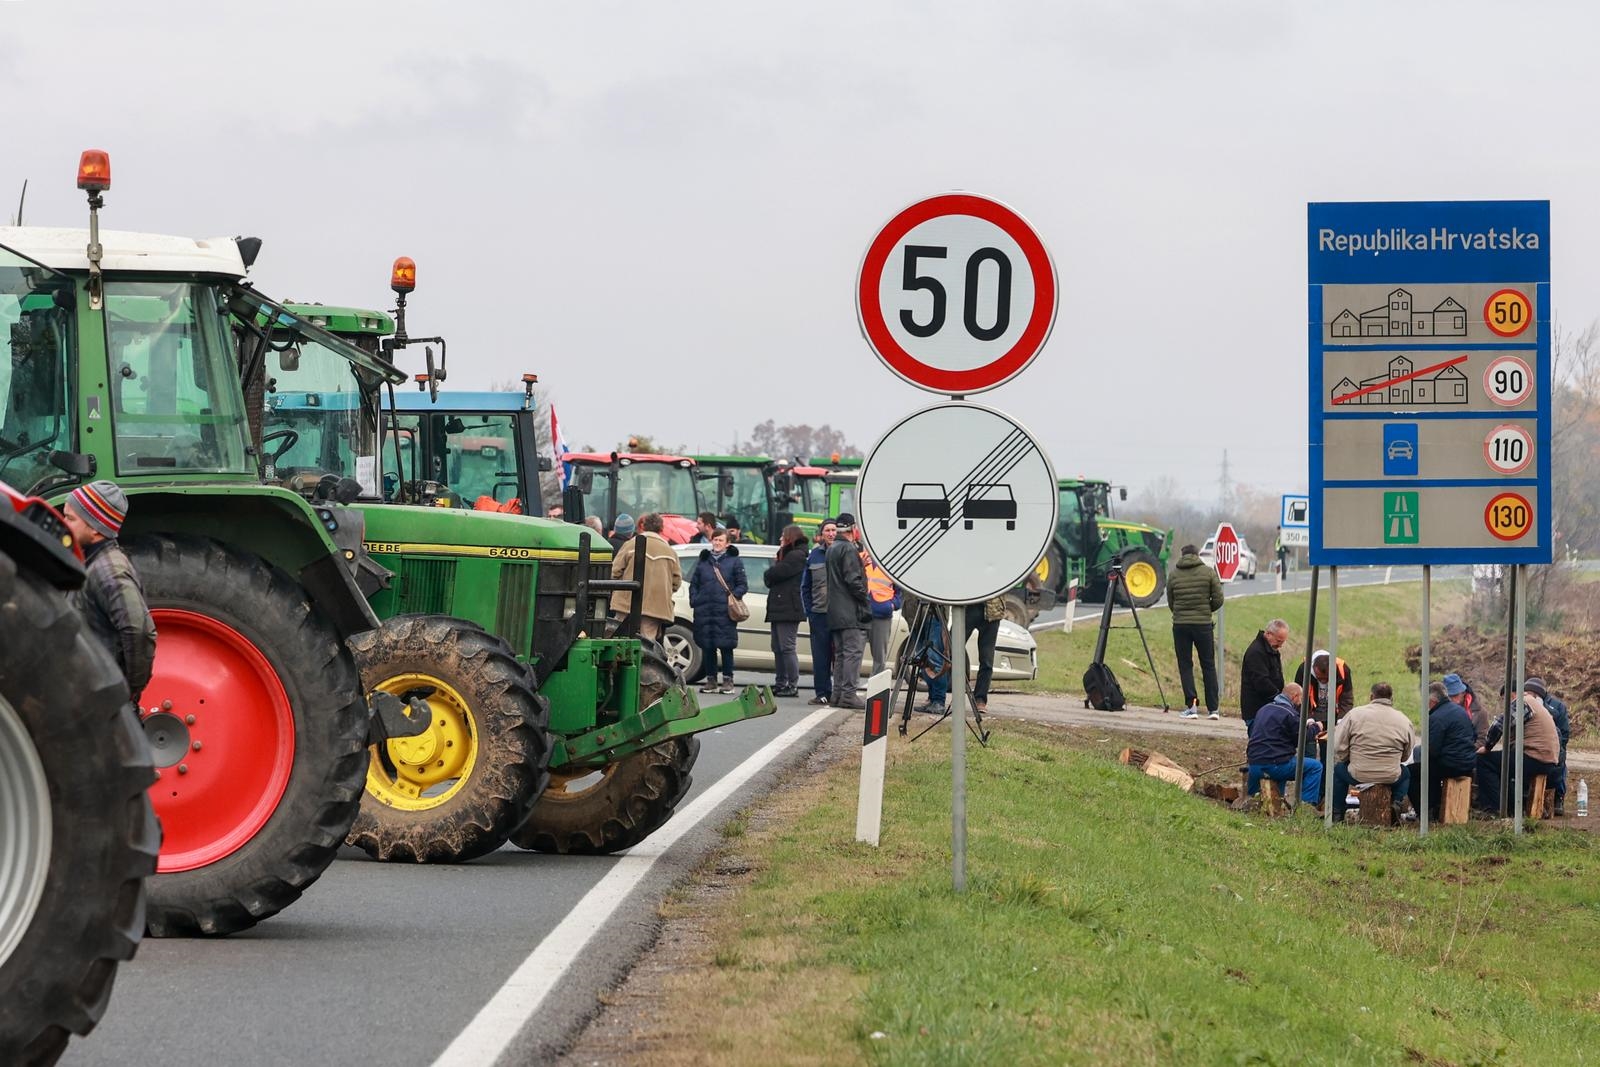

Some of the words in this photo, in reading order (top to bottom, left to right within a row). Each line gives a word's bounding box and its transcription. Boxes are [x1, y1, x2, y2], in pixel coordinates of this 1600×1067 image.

[899, 244, 1013, 342] 50
[1494, 301, 1522, 325] 50
[1494, 369, 1523, 394] 90
[1494, 438, 1524, 463] 110
[1493, 505, 1526, 528] 130
[1286, 532, 1300, 542] 350
[488, 548, 530, 558] 6400
[1216, 541, 1239, 564] STOP
